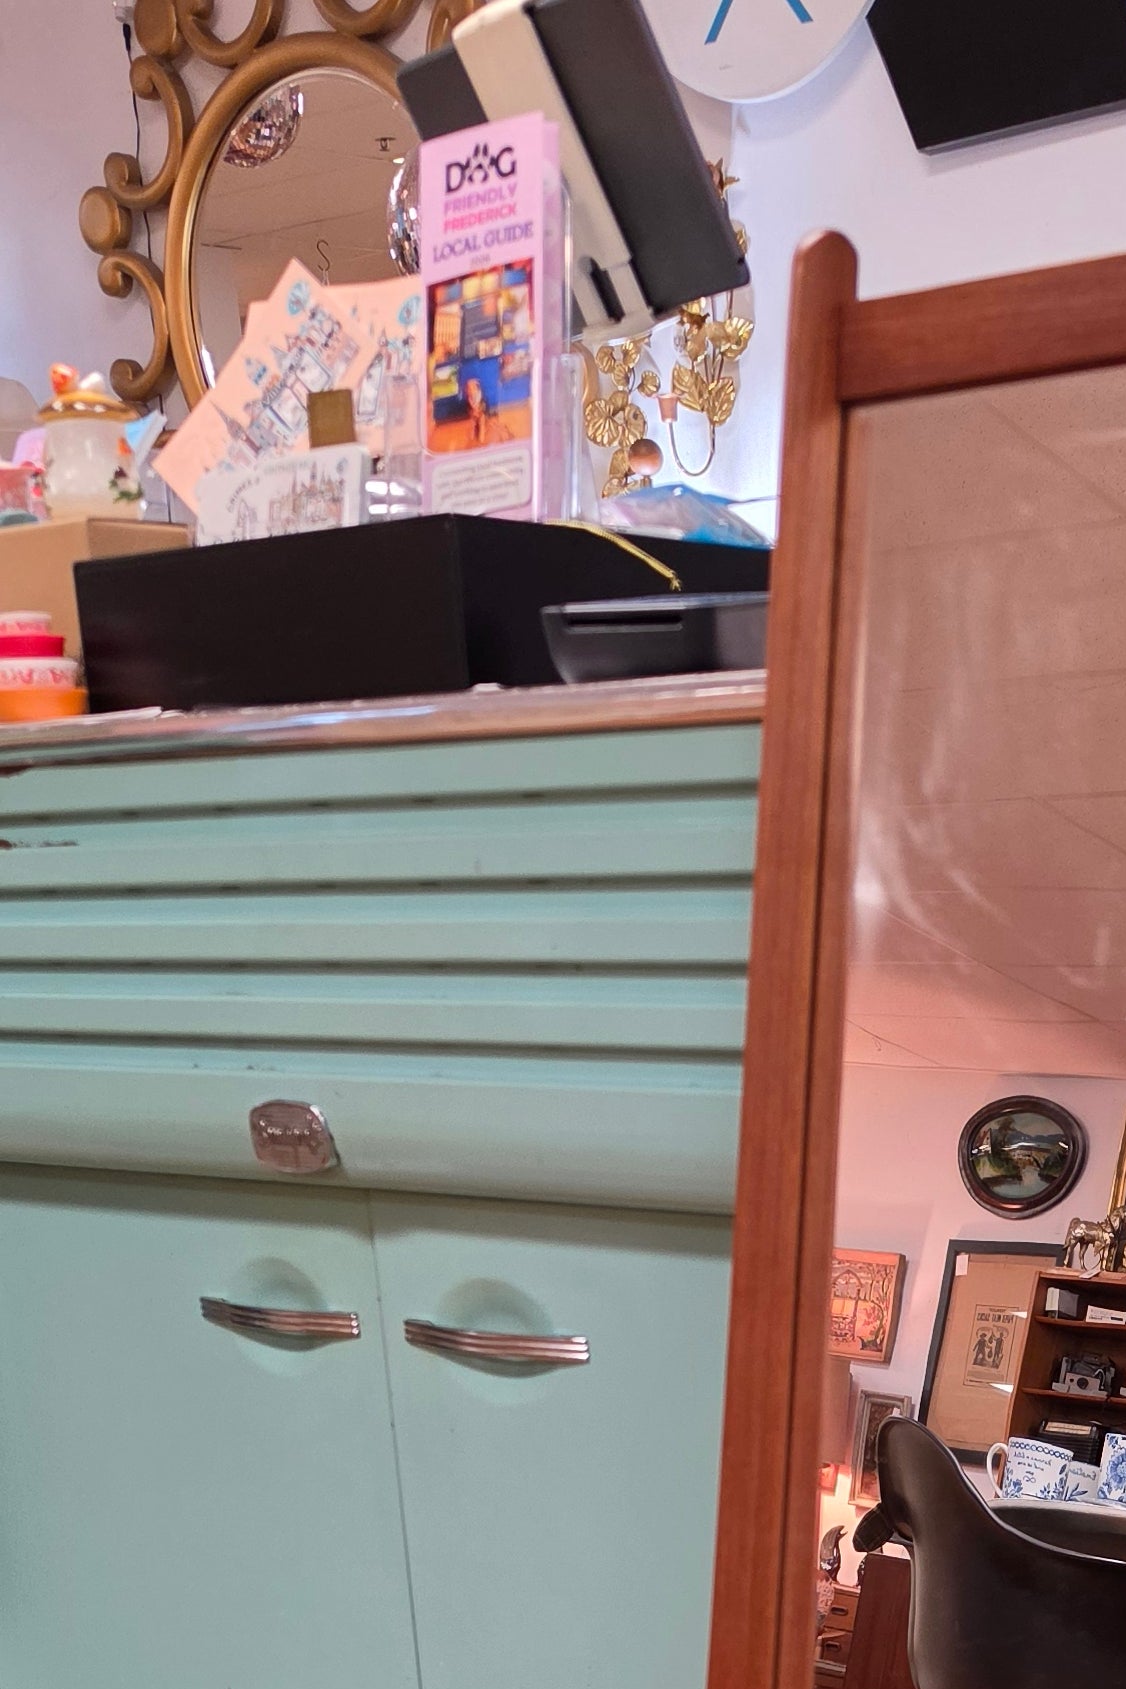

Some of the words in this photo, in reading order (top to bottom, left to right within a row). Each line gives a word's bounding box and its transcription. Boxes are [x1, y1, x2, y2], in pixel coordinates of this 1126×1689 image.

[444, 183, 517, 214] FRIENDLY
[444, 203, 516, 234] FREDERICK
[433, 235, 481, 263] LOCAL
[484, 220, 533, 247] GUIDE
